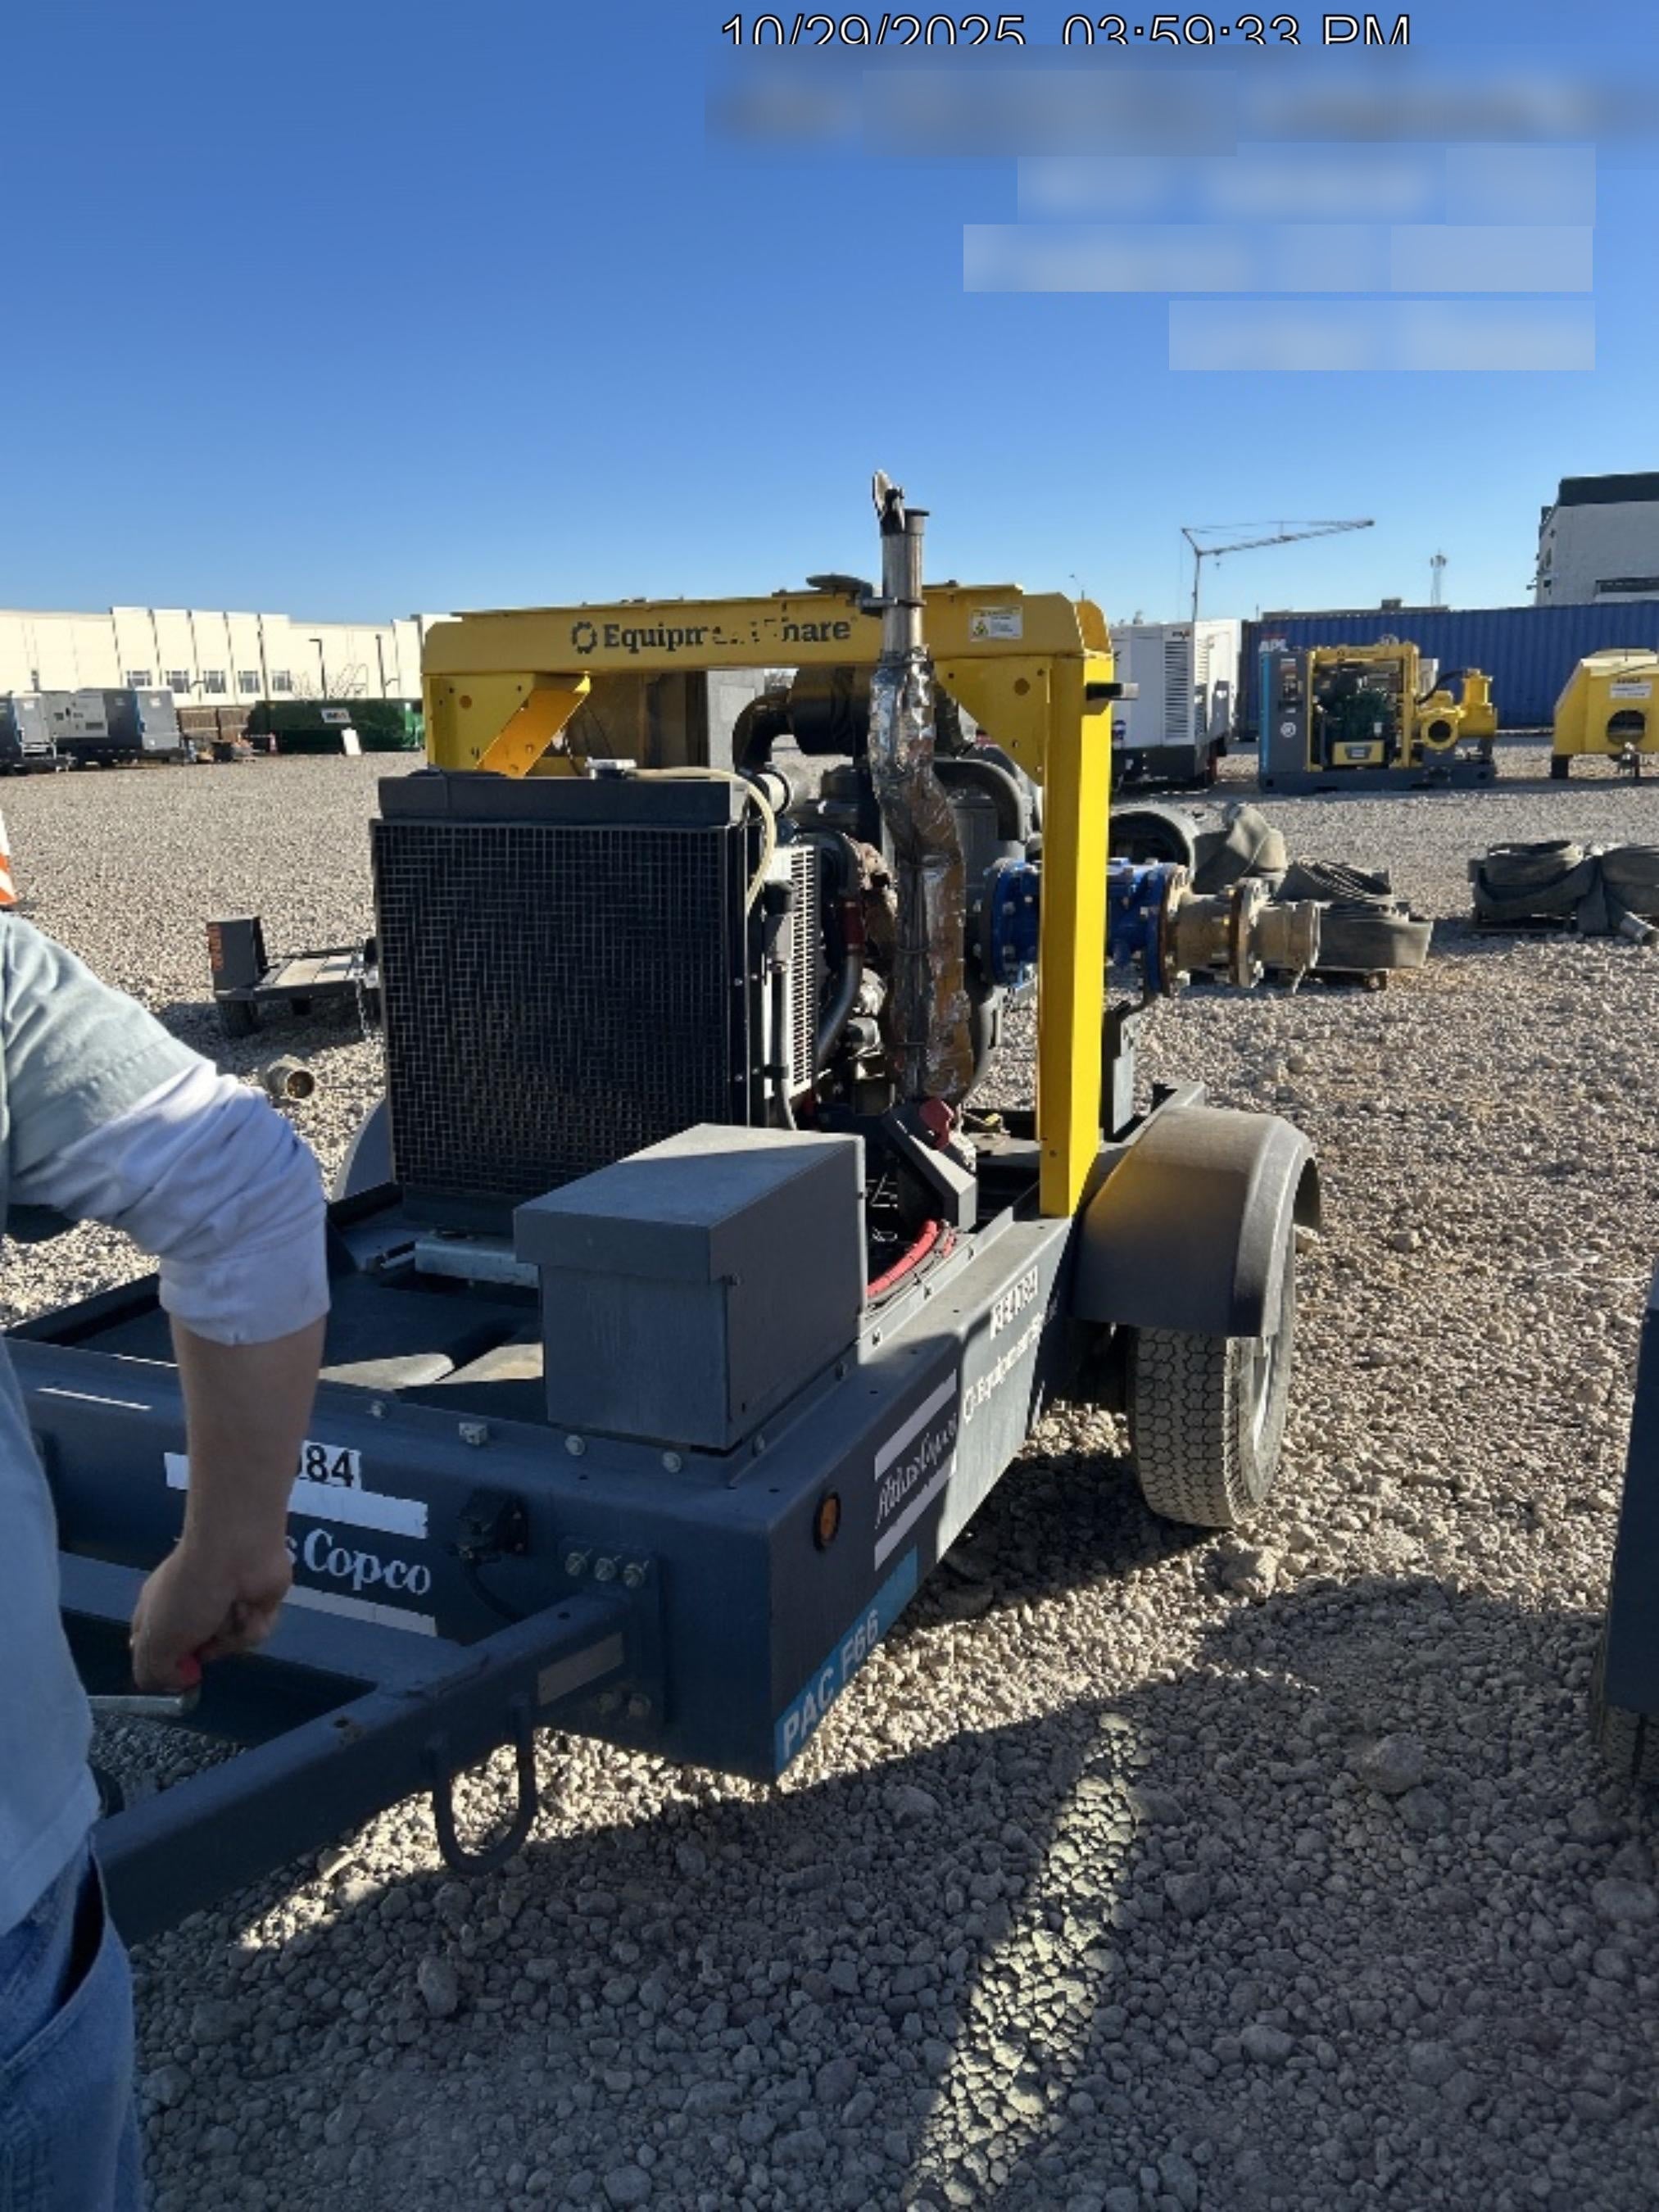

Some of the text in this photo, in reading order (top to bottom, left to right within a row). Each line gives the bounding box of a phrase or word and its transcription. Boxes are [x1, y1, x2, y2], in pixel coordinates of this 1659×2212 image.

[304, 1529, 432, 1596] Copco
[783, 1608, 878, 1759] PAC F66
